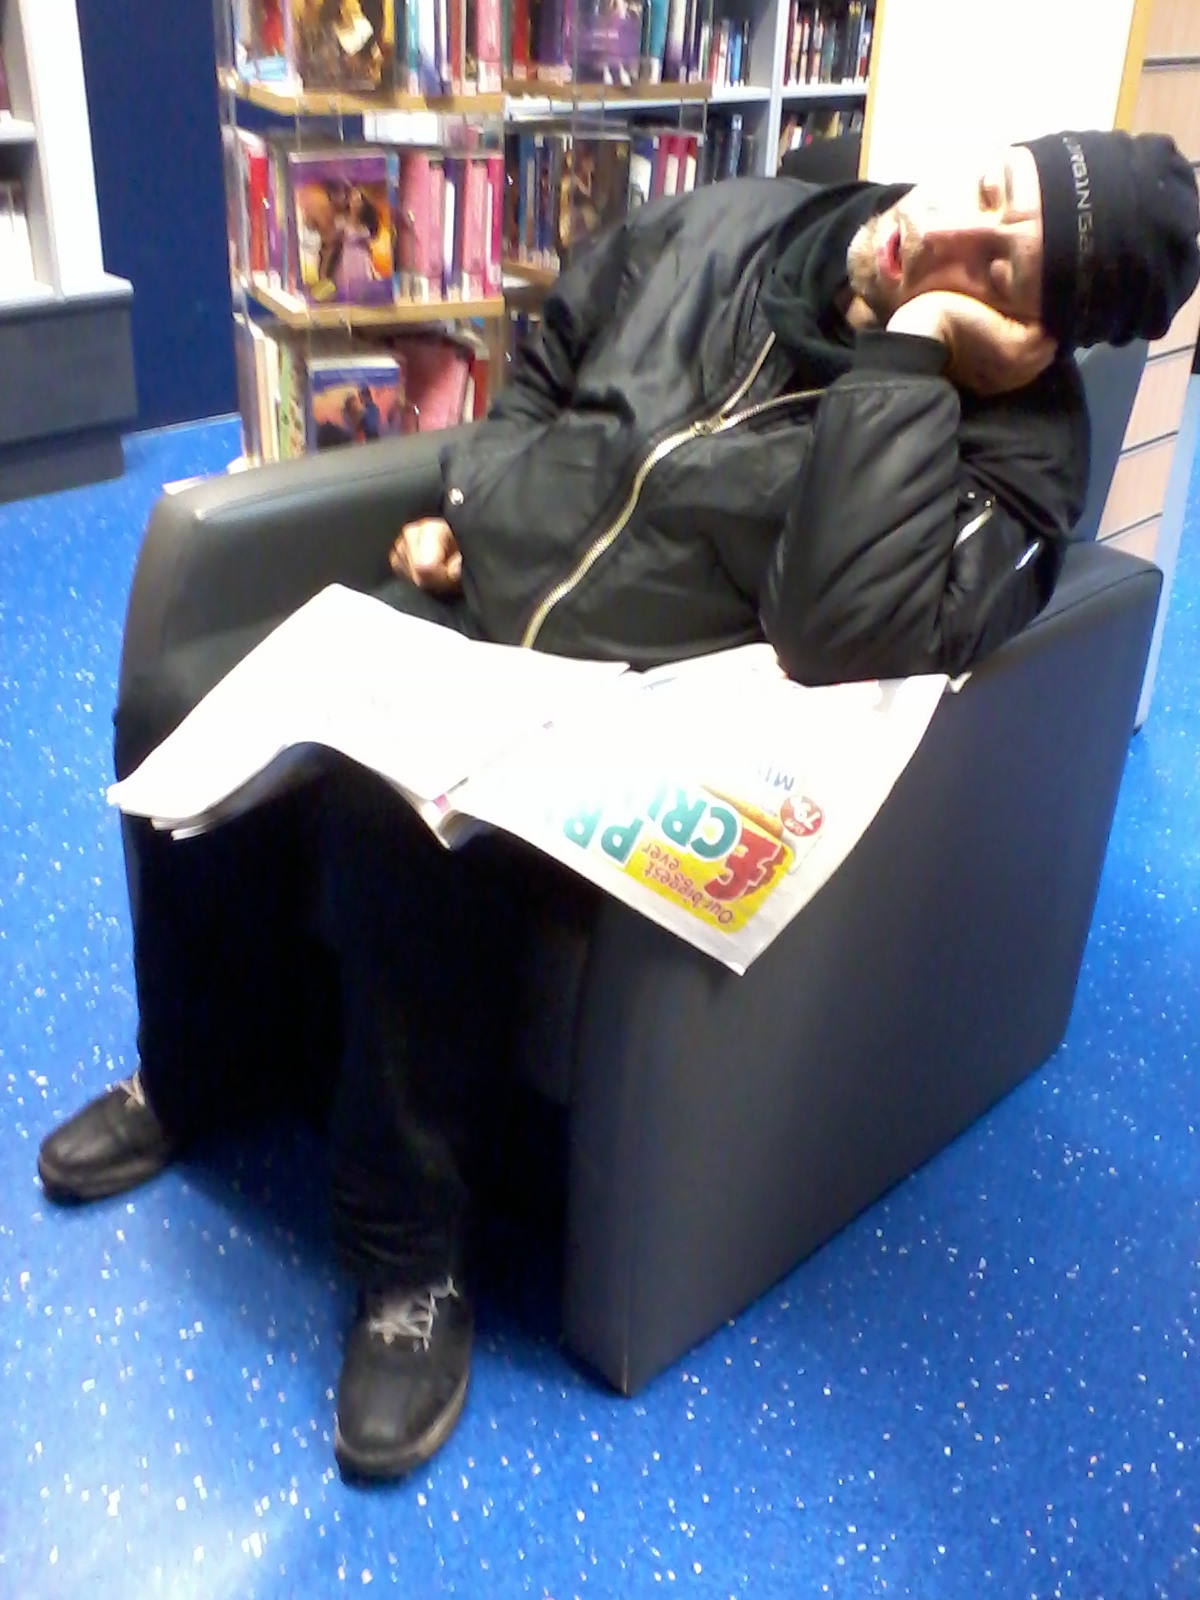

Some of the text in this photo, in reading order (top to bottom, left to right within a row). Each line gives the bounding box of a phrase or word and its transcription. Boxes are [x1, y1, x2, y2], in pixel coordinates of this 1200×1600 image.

[640, 842, 681, 870] ever
[642, 861, 735, 925] Our biggest
